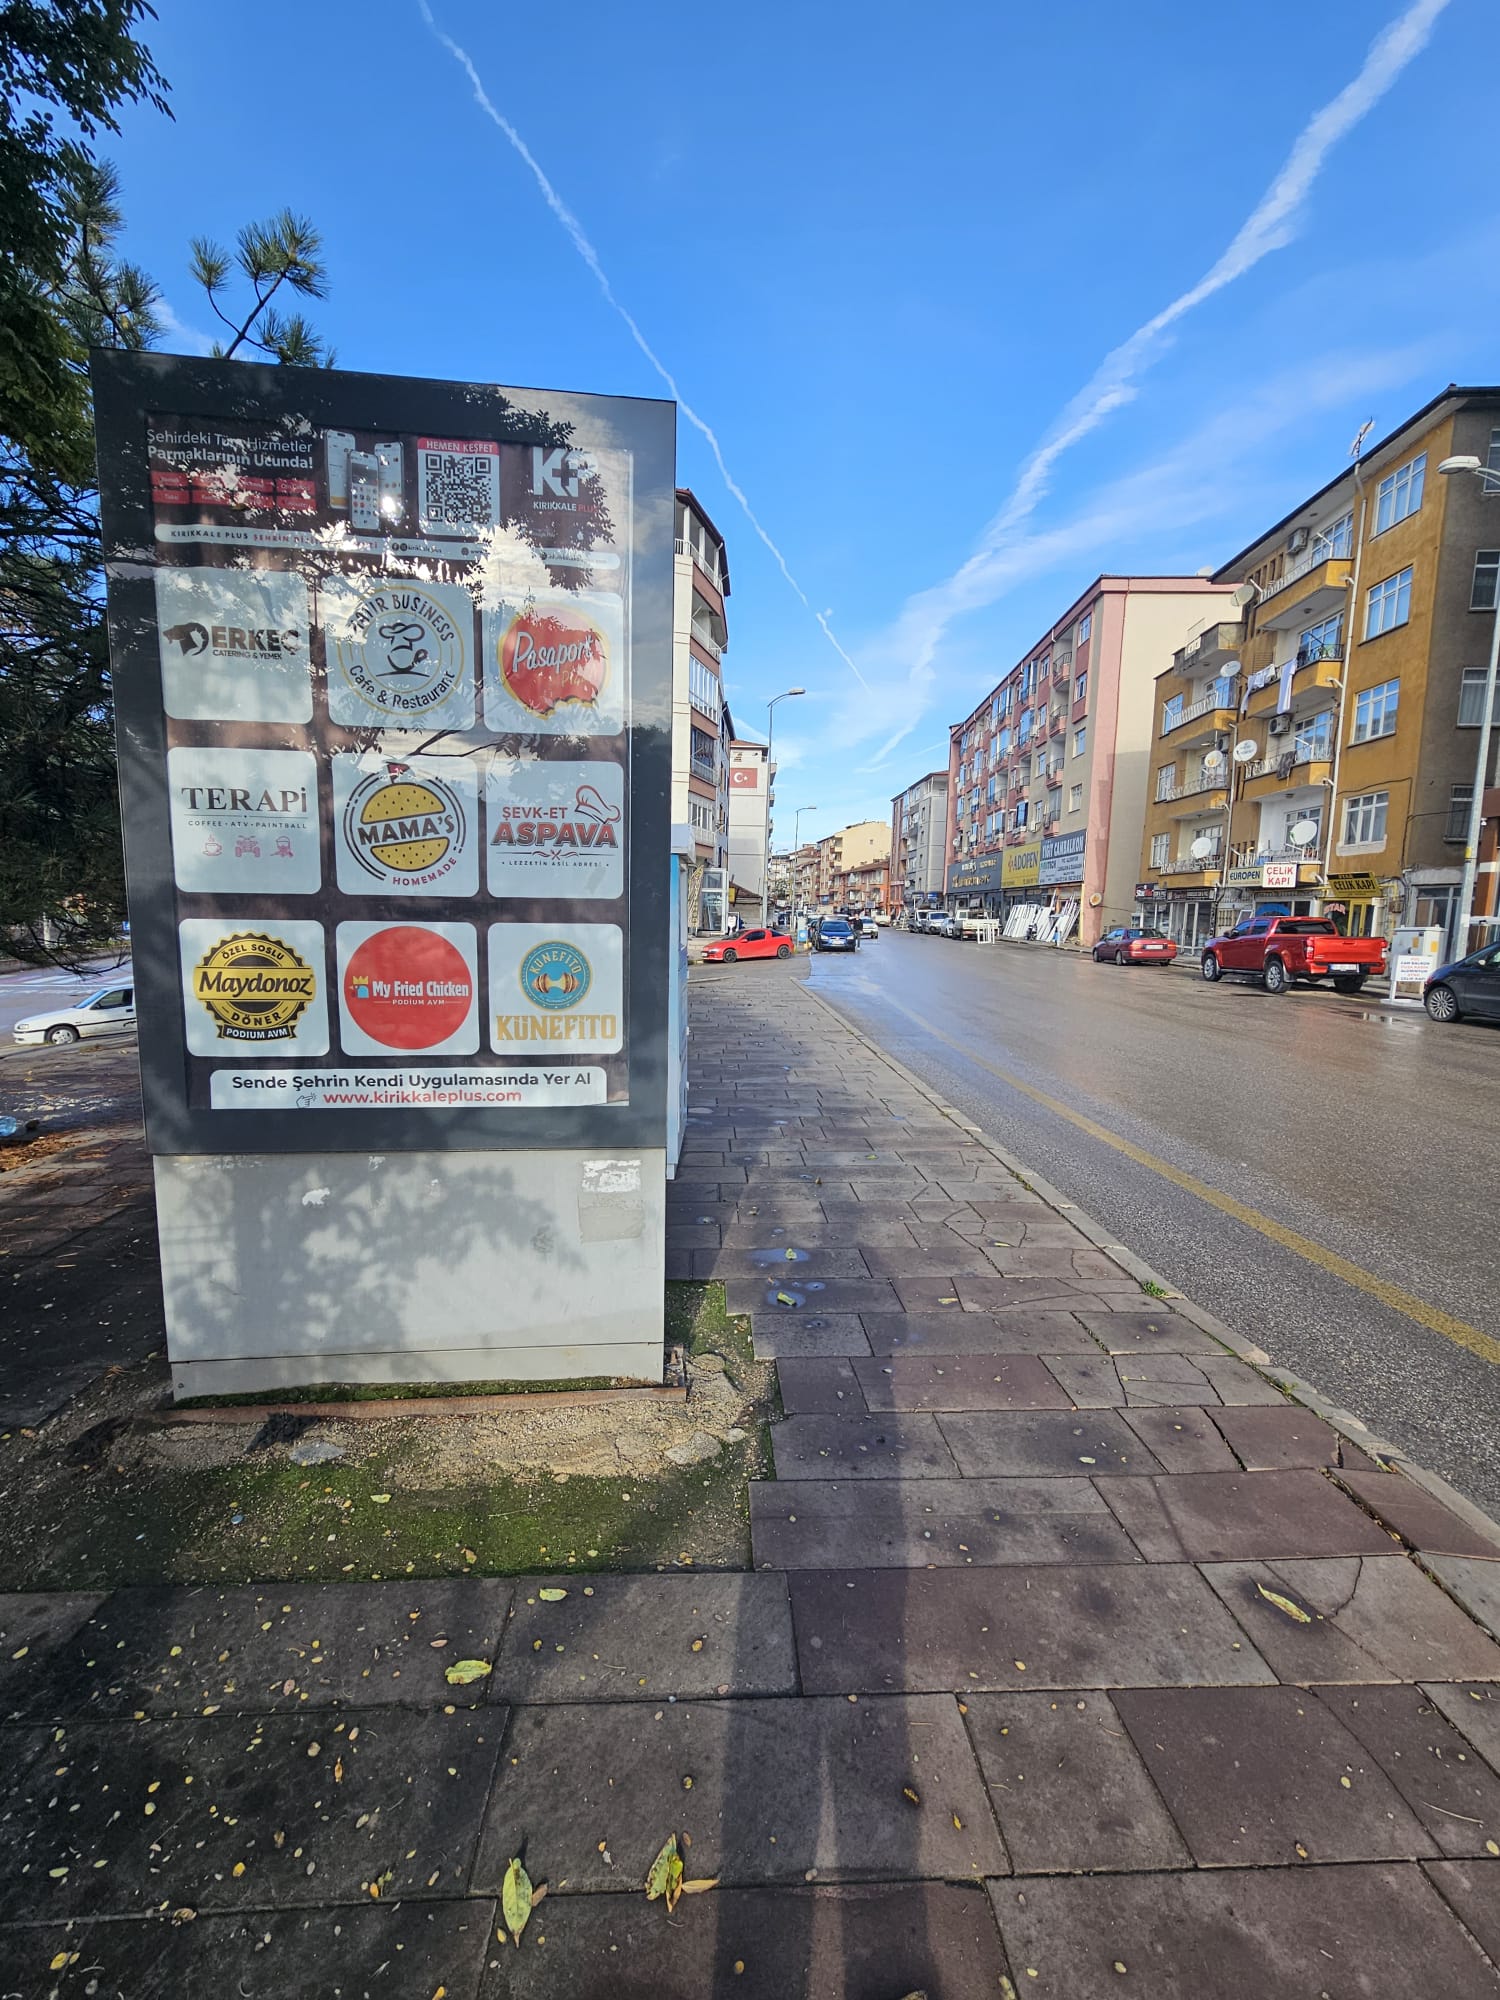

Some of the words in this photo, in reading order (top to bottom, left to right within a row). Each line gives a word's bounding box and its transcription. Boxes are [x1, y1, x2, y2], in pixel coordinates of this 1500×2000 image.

[426, 441, 460, 452] HEMEN
[463, 443, 493, 454] KEŞFET
[254, 453, 313, 469] Ucunda!
[533, 501, 577, 511] KIRIKKALE
[170, 529, 222, 538] KIRIKKALE
[212, 649, 251, 659] CATERING
[259, 652, 283, 660] YEMEK
[513, 631, 594, 674] Pasaport
[349, 665, 376, 696] Cafe
[376, 689, 388, 705] &
[392, 671, 455, 709] Restaurant
[502, 806, 568, 821] ŞEVK-ET
[490, 822, 618, 848] ASPAVA
[1012, 850, 1039, 871] ADOPEN
[392, 856, 456, 886] HOMEMADE
[1230, 871, 1260, 880] EUROPEN
[1267, 877, 1290, 886] KAPI
[1355, 880, 1376, 889] KAPI
[222, 944, 247, 960] ÖZEL
[251, 944, 284, 960] SOSLU
[199, 970, 313, 998] Maydonoz
[372, 980, 390, 998] My
[393, 980, 423, 997] Fried
[426, 981, 469, 997] Chicken
[231, 1011, 281, 1026] DÖNER
[226, 1028, 265, 1039] PODIUM
[267, 1028, 288, 1038] AVM
[232, 1076, 288, 1089] Sende
[292, 1075, 350, 1092] Şehrin
[354, 1074, 404, 1088] Kendi
[408, 1073, 539, 1089] Uygulamasında
[543, 1073, 570, 1085] Yer
[574, 1072, 591, 1085] Al
[323, 1089, 522, 1105] www.kirikkaleplus.com
